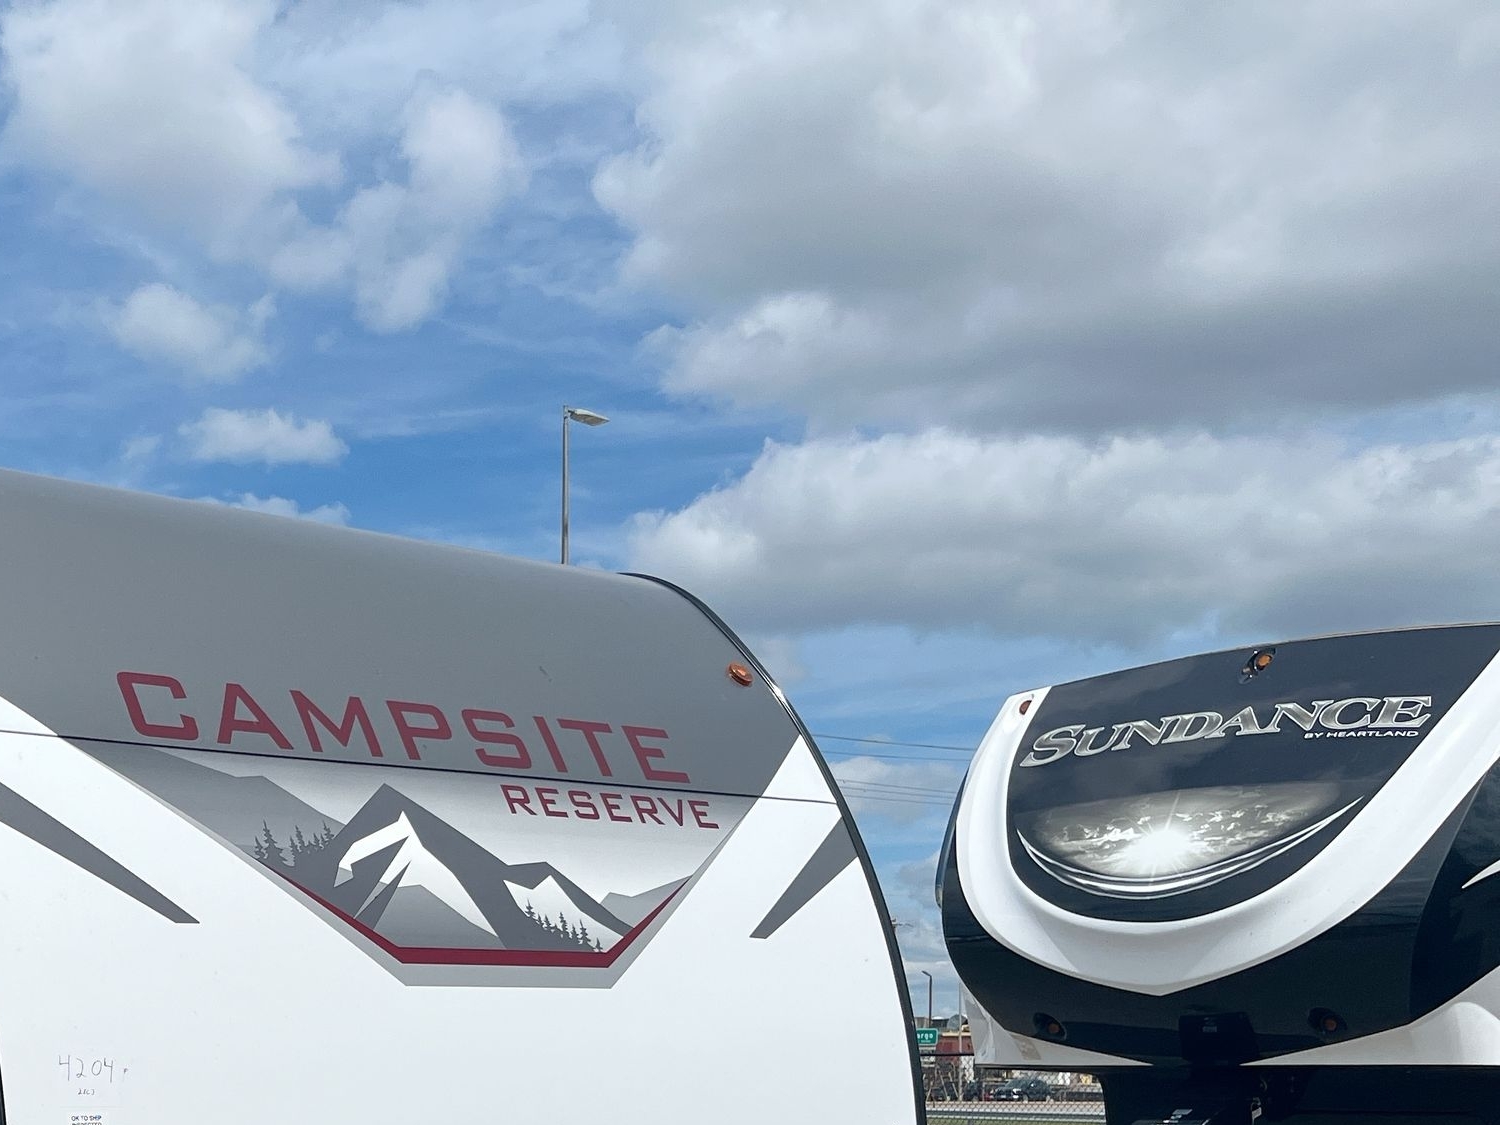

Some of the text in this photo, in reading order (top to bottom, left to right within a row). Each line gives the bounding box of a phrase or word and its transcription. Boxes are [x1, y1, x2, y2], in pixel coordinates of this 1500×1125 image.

[116, 671, 691, 784] CAMPSITE
[1019, 696, 1432, 768] SUNDANCE
[1303, 729, 1419, 740] BY HEARTLAND
[501, 784, 720, 830] RESERVE
[58, 1054, 114, 1083] 4204
